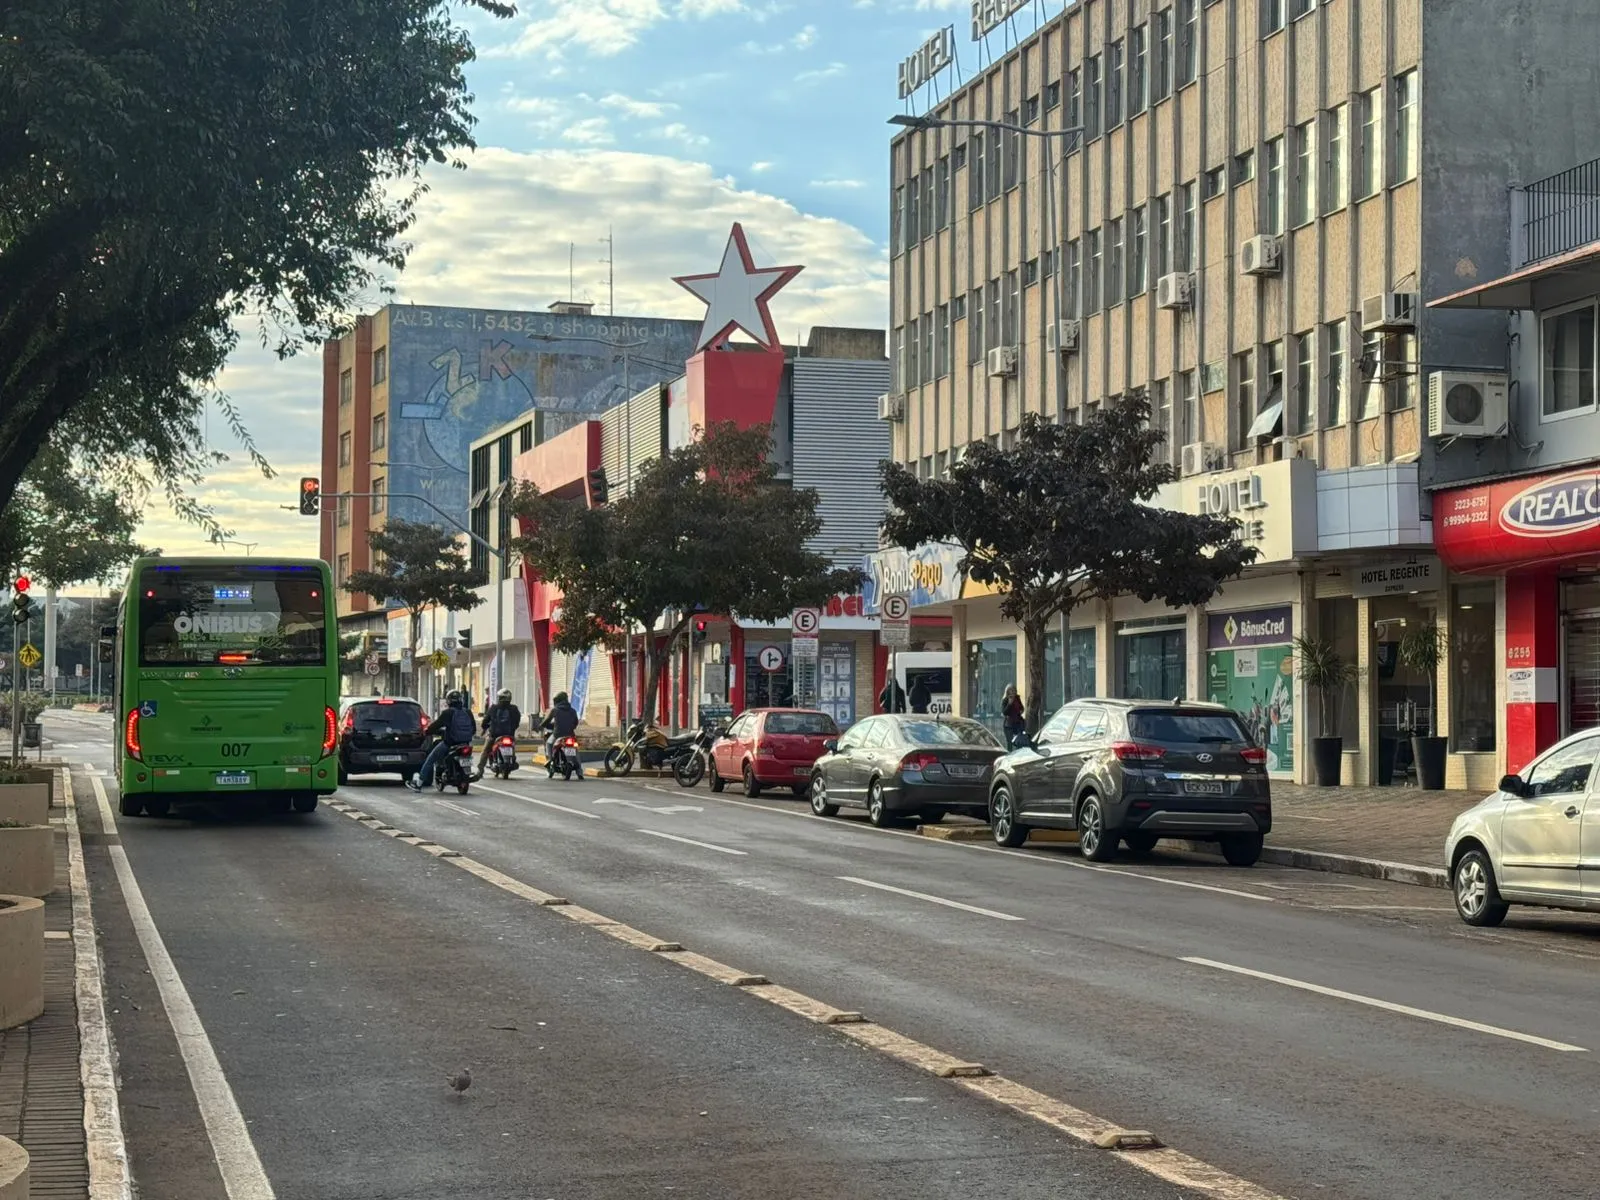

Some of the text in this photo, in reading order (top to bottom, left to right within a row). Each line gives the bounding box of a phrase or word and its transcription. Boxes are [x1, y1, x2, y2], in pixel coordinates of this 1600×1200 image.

[897, 26, 954, 99] HOTEL
[1198, 474, 1266, 516] HOTEL
[883, 559, 942, 595] BonusPago
[1361, 564, 1430, 584] HOTEL REGENTE
[891, 600, 901, 614] E
[173, 610, 263, 633] ÔNIBUS
[801, 615, 810, 627] E
[1240, 617, 1285, 637] BônusCred
[221, 743, 251, 757] 007
